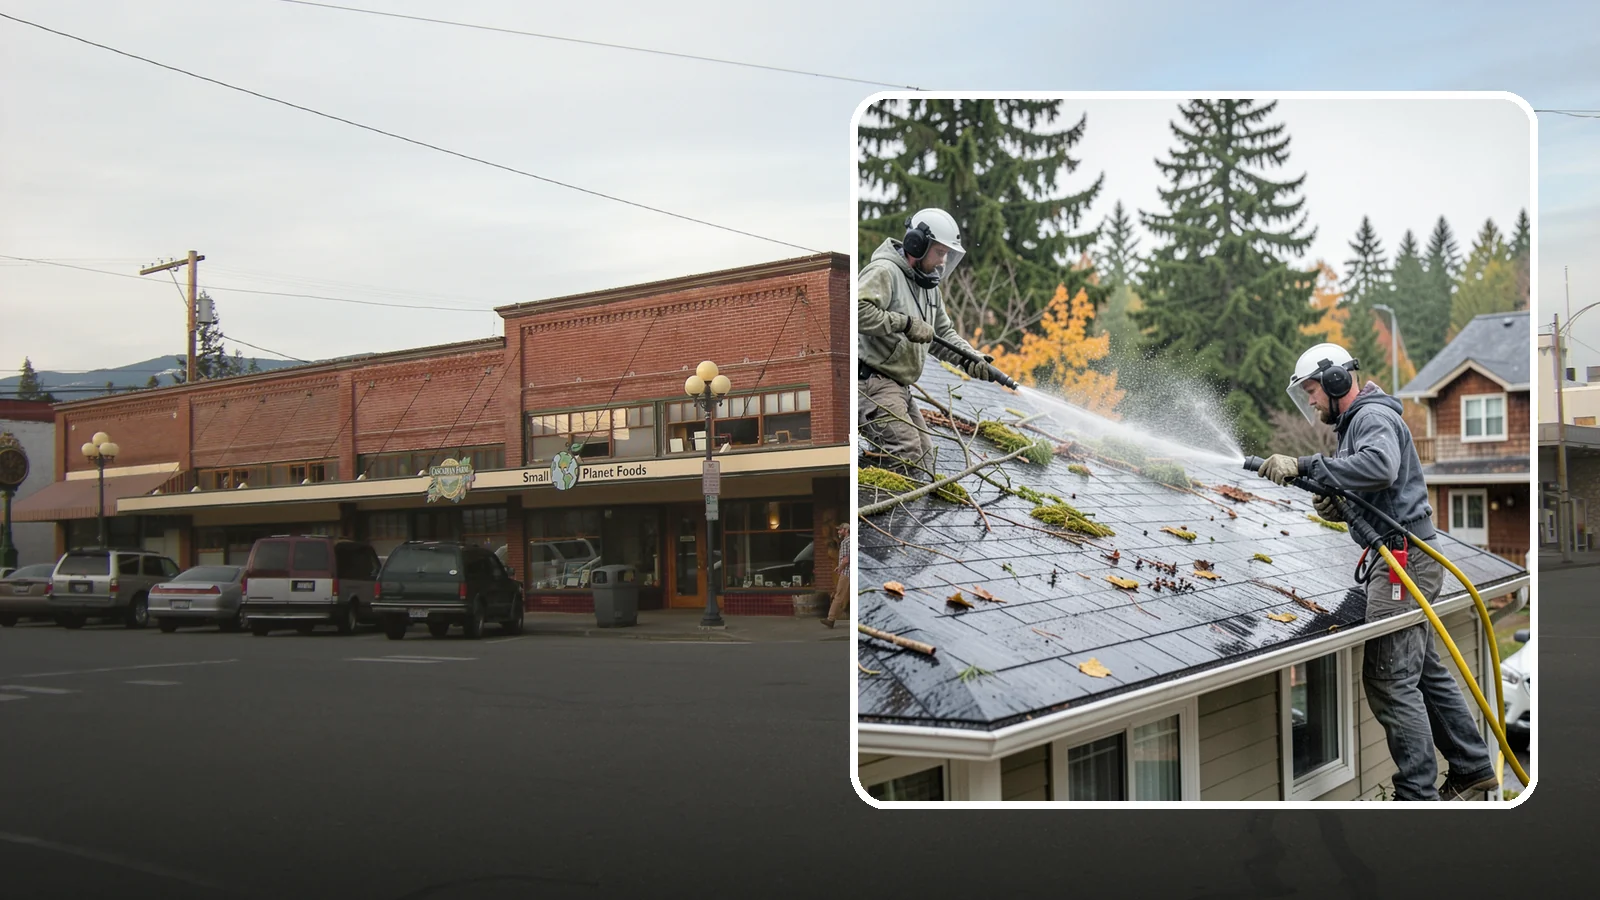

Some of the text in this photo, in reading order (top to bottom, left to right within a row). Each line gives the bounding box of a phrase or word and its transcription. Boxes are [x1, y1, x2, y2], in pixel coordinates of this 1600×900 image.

[523, 464, 647, 482] Small Planet Foods
